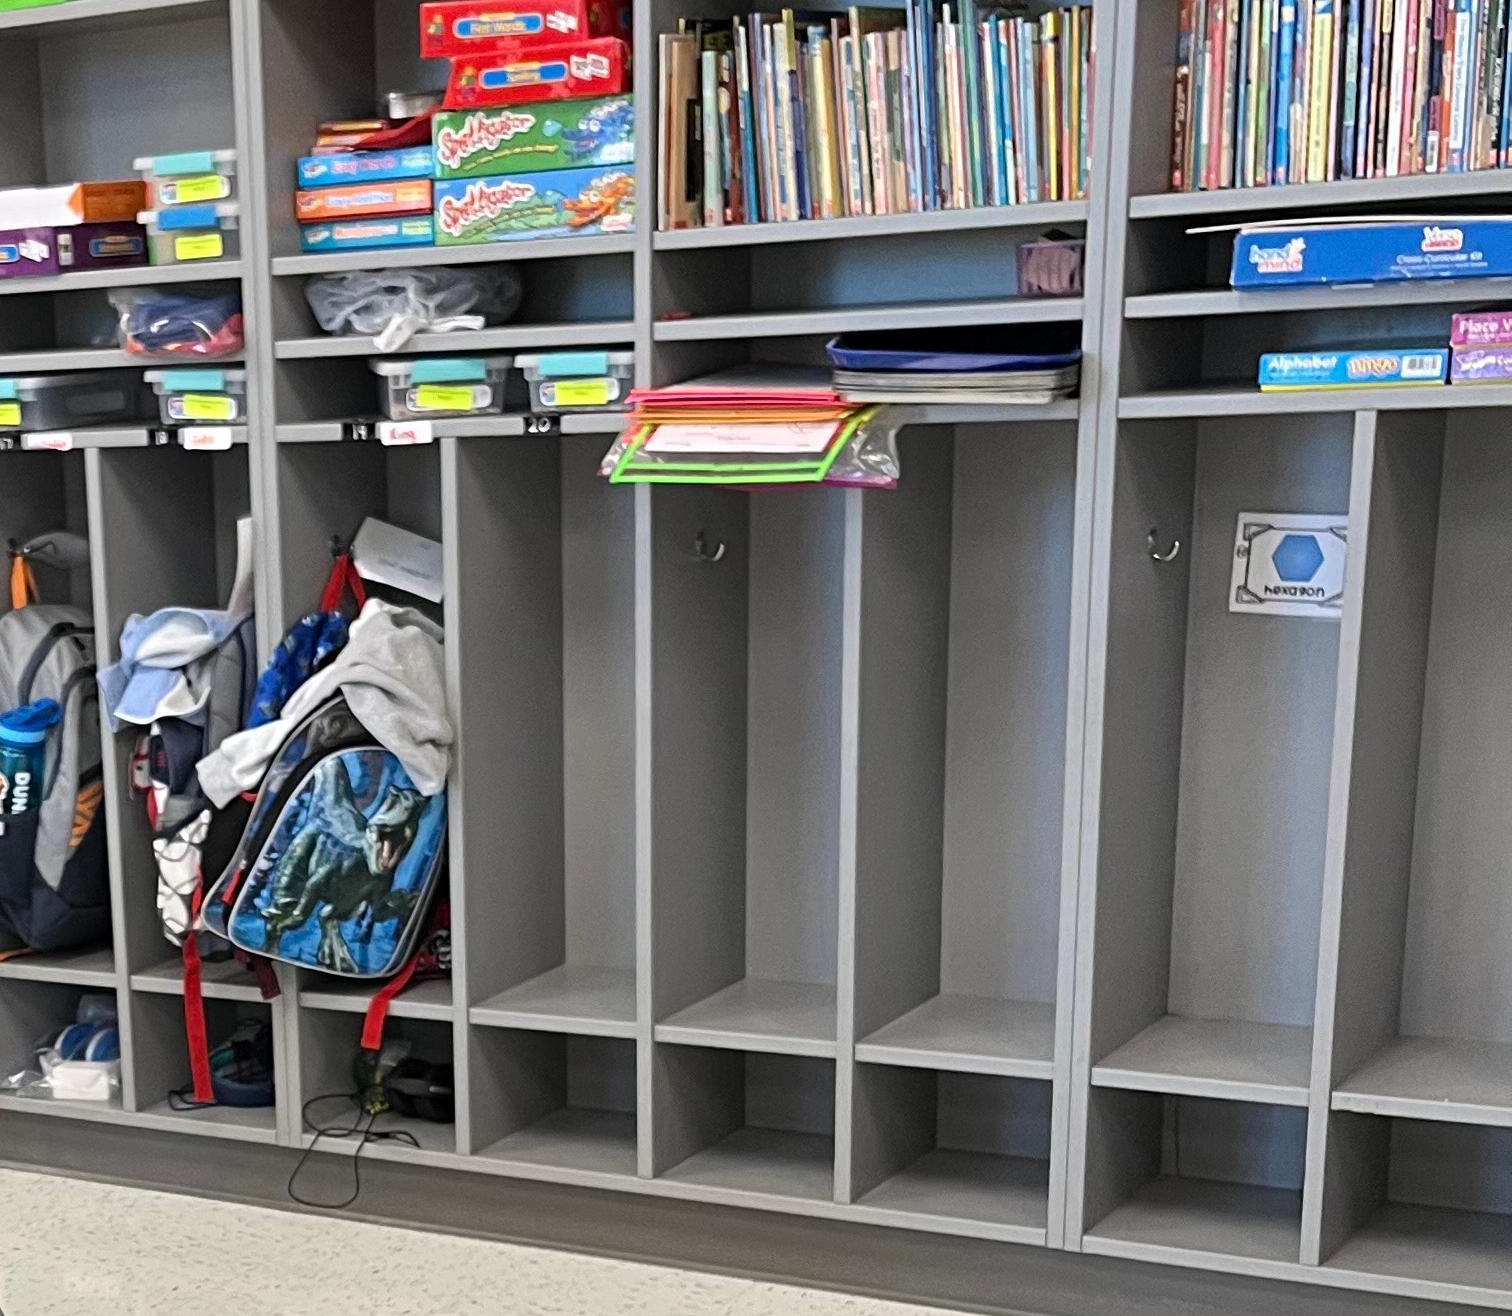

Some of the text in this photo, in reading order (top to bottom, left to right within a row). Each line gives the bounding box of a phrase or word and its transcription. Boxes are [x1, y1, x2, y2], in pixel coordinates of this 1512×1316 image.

[1459, 319, 1499, 334] Place
[1268, 355, 1337, 370] Alphabet
[1264, 585, 1325, 597] hexagon
